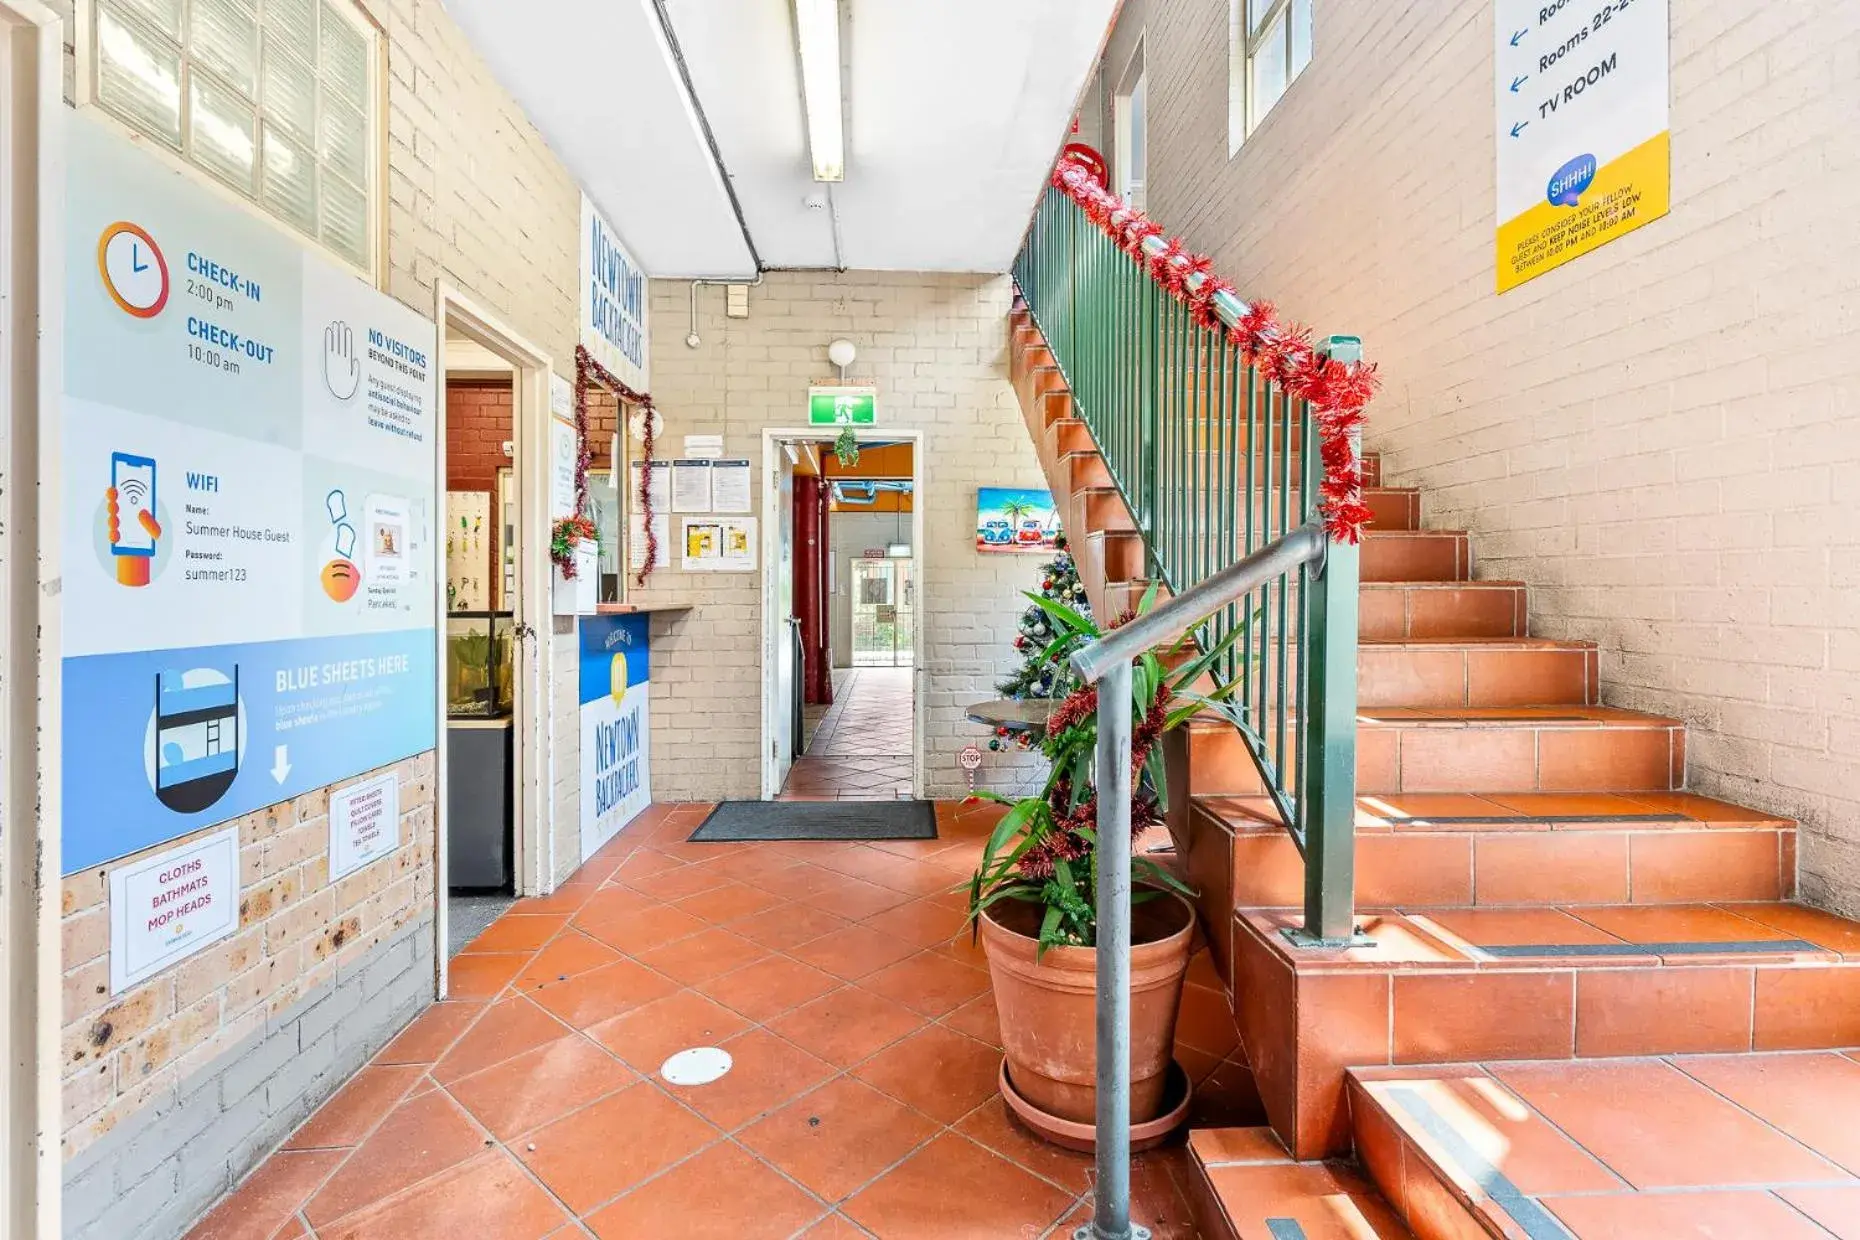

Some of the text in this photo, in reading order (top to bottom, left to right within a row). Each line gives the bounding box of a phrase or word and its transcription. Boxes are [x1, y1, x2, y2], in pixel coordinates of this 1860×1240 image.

[1539, 0, 1570, 26] Roo
[1539, 0, 1635, 73] Rooms 22-2
[1538, 52, 1617, 119] TV ROOM
[1551, 160, 1592, 198] SHHH!
[1511, 191, 1641, 265] GUEST AND KEEP NOISE LEVELS LOW
[1541, 213, 1577, 238] CONSIDER
[1579, 201, 1600, 219] YOUR
[1603, 183, 1633, 206] FELLOW
[1515, 253, 1545, 273] BETWEEN
[1565, 236, 1578, 250] PM
[1580, 227, 1597, 242] AND
[1621, 206, 1636, 222] AM
[187, 251, 261, 303] CHECK-IN
[591, 213, 643, 329] NEWTOWN
[187, 278, 234, 312] 2:00 pm
[187, 316, 274, 365] CHECK-OUT
[591, 280, 643, 370] BACKPACKERS
[187, 343, 240, 375] 10:00 am
[368, 327, 427, 369] NO VISITORS
[368, 347, 426, 383] BEYOND THIS POINT
[186, 471, 218, 492] WIFI
[185, 503, 209, 516] Name:
[186, 520, 290, 543] Summer House Guest
[185, 549, 223, 560] Password:
[185, 568, 247, 582] summer123
[275, 653, 410, 693] BLUE SHEETS HERE
[595, 704, 640, 775] NEWTOWN
[961, 754, 980, 762] STOP
[595, 755, 640, 819] BACKPACKERS
[159, 858, 202, 884] CLOTHS
[152, 875, 208, 908] BATHMATS
[147, 893, 212, 933] MOP HEADS
